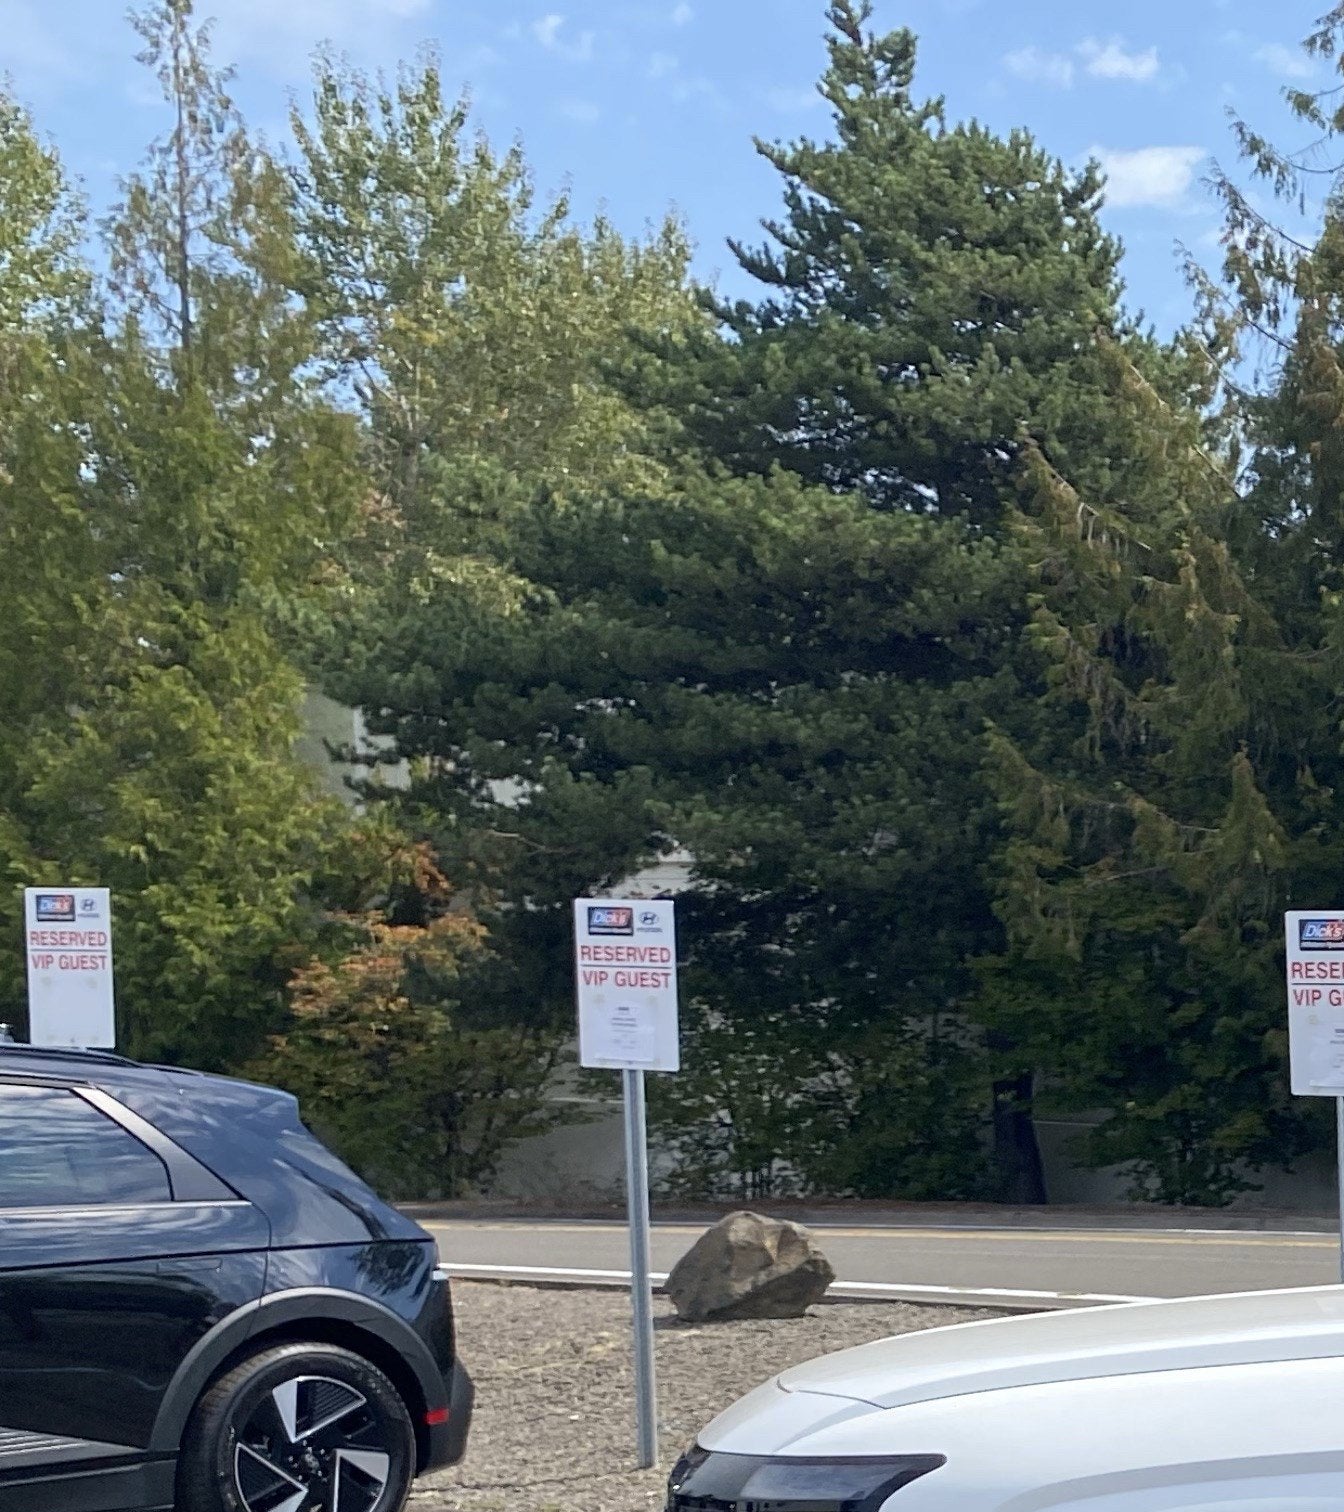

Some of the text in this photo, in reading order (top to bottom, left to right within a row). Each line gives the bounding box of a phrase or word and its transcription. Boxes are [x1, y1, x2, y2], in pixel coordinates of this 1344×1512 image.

[30, 931, 107, 946] RESERVED
[32, 955, 107, 970] VIP GUEST
[580, 945, 671, 963] RESERVED
[582, 971, 672, 989] VIP GUEST
[1293, 989, 1322, 1006] VIP
